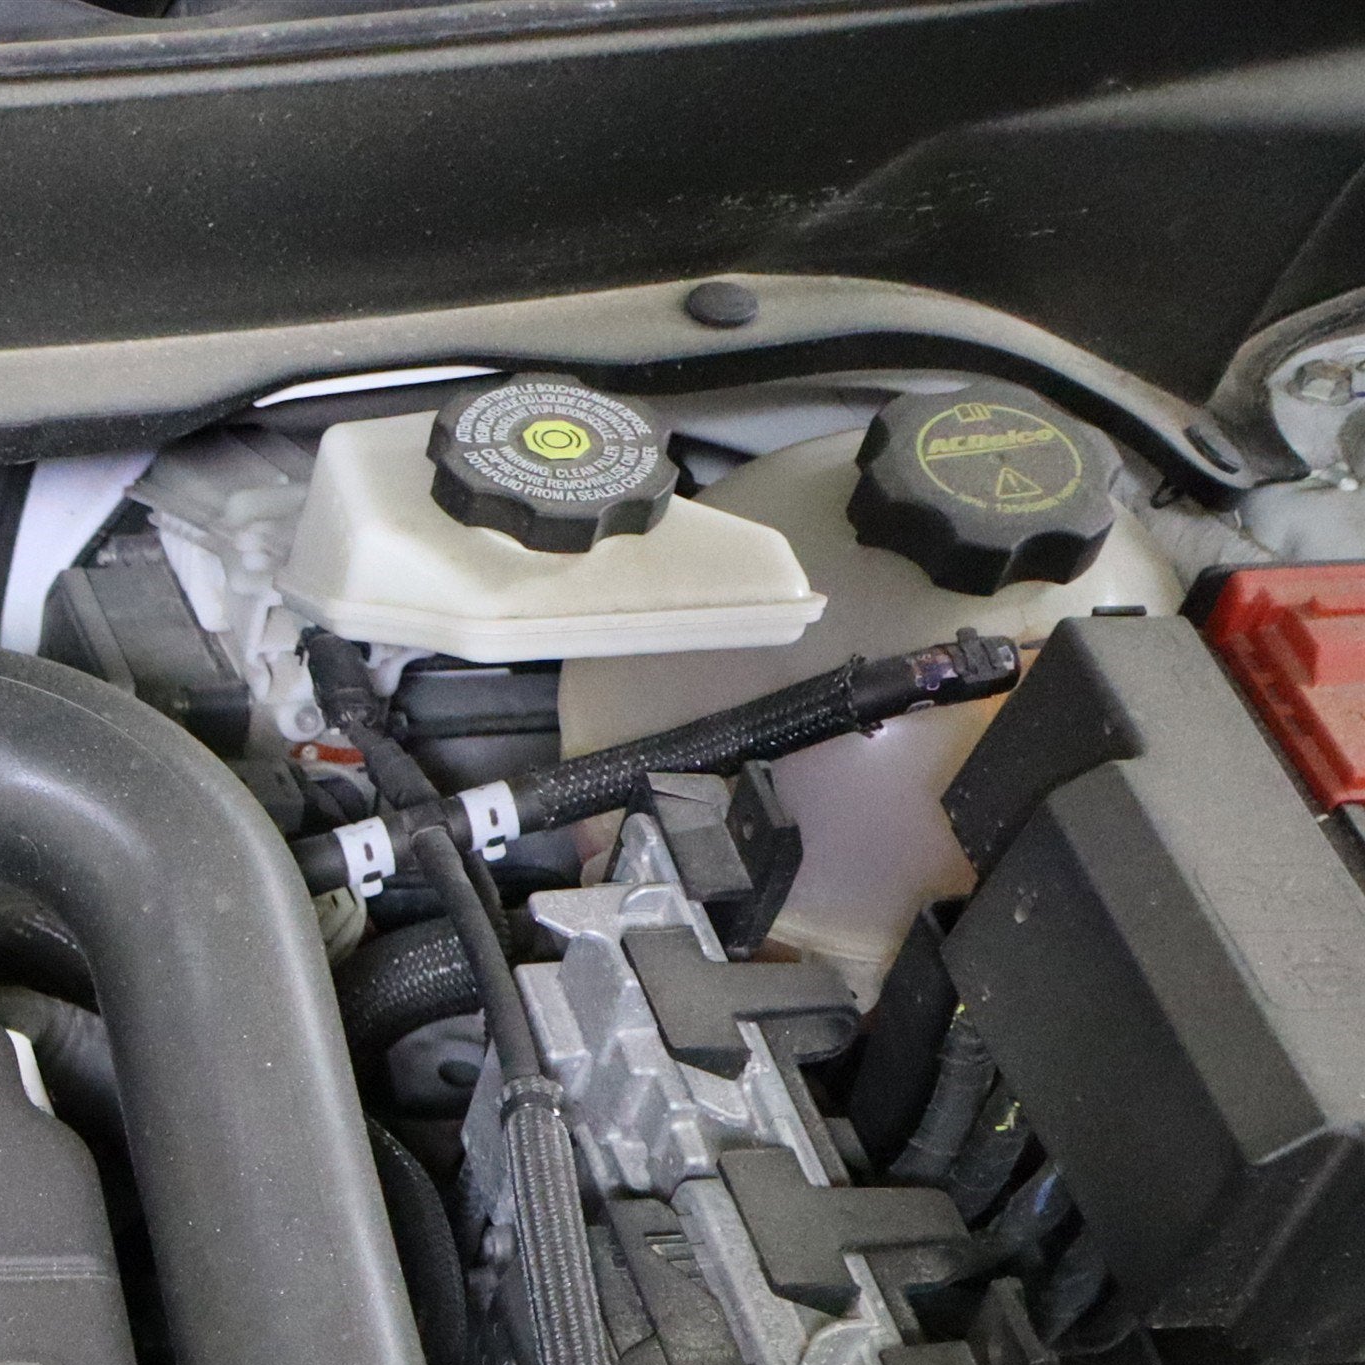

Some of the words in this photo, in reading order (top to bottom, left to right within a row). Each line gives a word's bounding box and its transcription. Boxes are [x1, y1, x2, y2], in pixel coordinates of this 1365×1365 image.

[486, 470, 524, 491] FLUID
[524, 484, 564, 500] FROM
[566, 491, 577, 501] A
[576, 483, 626, 501] SEALED
[497, 462, 546, 487] BEFORE
